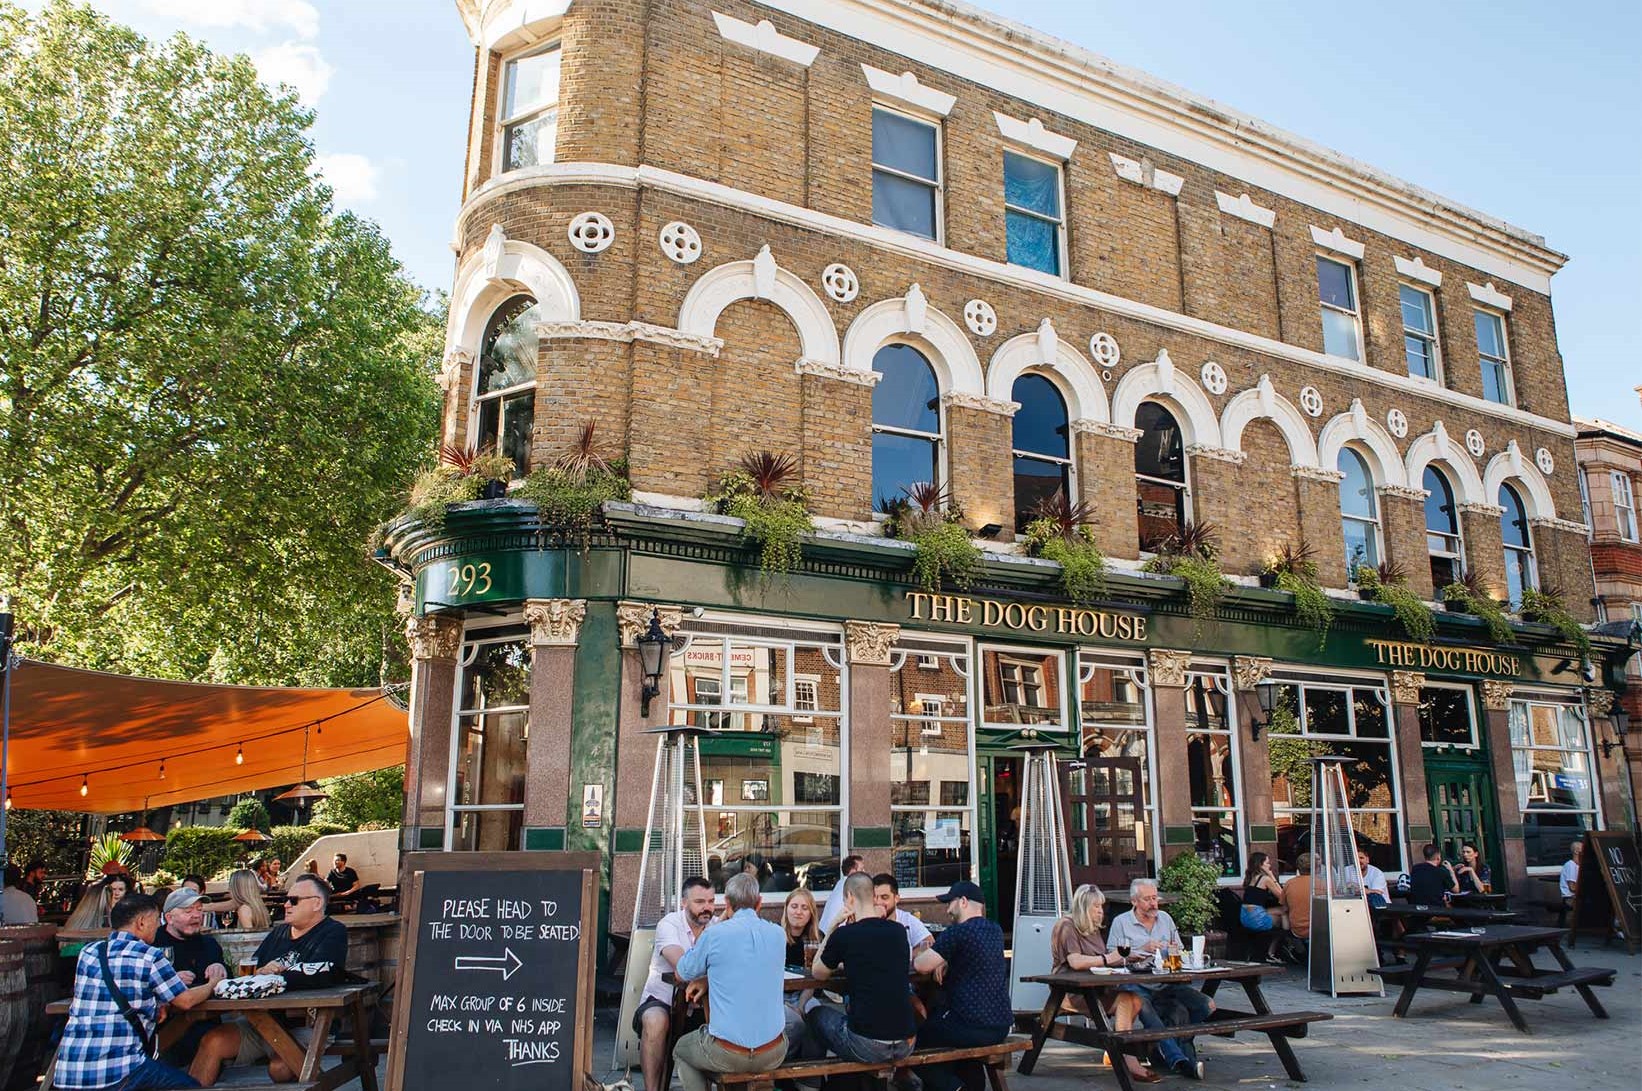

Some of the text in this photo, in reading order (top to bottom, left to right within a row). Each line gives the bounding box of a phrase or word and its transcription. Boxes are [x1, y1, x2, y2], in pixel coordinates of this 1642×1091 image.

[447, 562, 493, 597] 293
[906, 592, 1148, 641] THE DOG HOUSE
[1373, 642, 1522, 677] THE DOG HOUSE
[442, 898, 558, 920] PLEASE HEAD TO
[428, 920, 582, 941] THE DOOR TO BE SEATED!
[430, 994, 567, 1013] MAX GROUP OF 6 INSIDE
[427, 1018, 561, 1035] CHECK IN VIA NHS APP
[502, 1039, 560, 1060] THANKS
